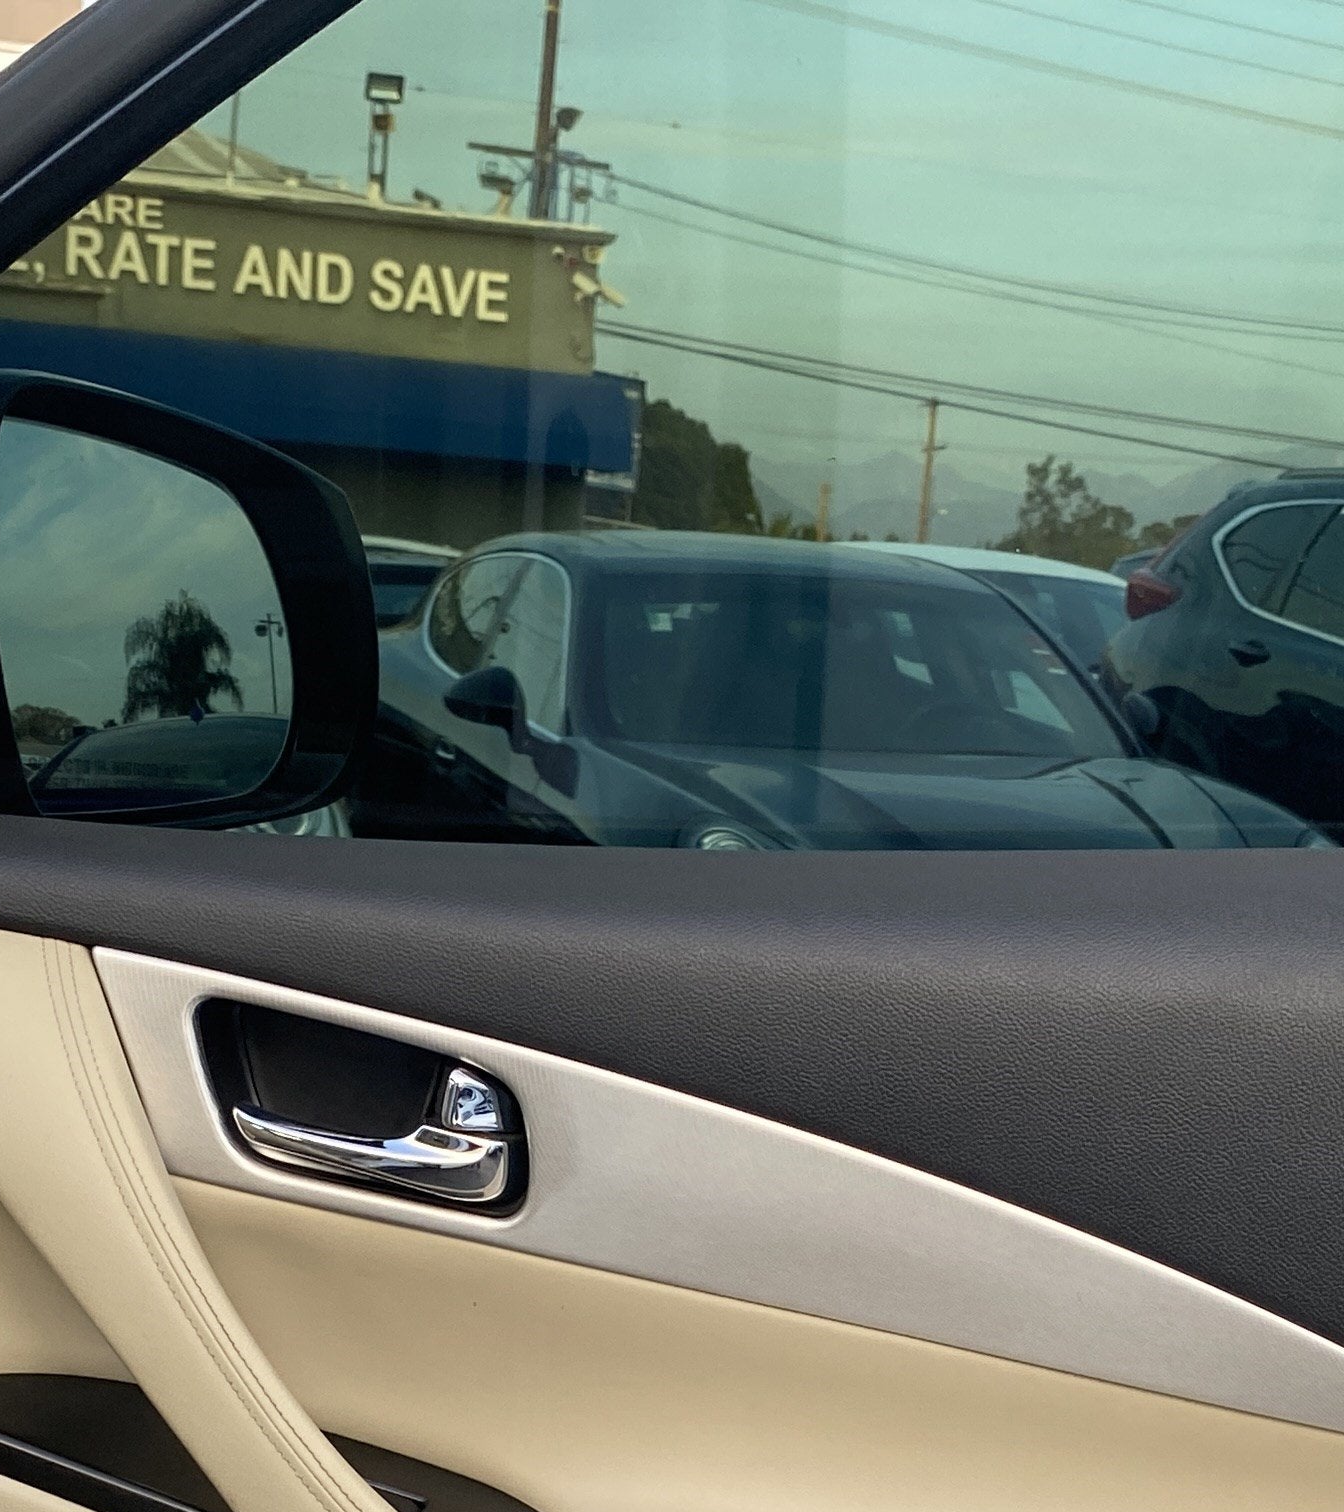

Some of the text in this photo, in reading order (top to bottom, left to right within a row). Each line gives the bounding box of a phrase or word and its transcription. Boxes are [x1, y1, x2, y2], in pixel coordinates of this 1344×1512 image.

[72, 193, 165, 230] ARE
[64, 225, 510, 323] RATE AND SAVE
